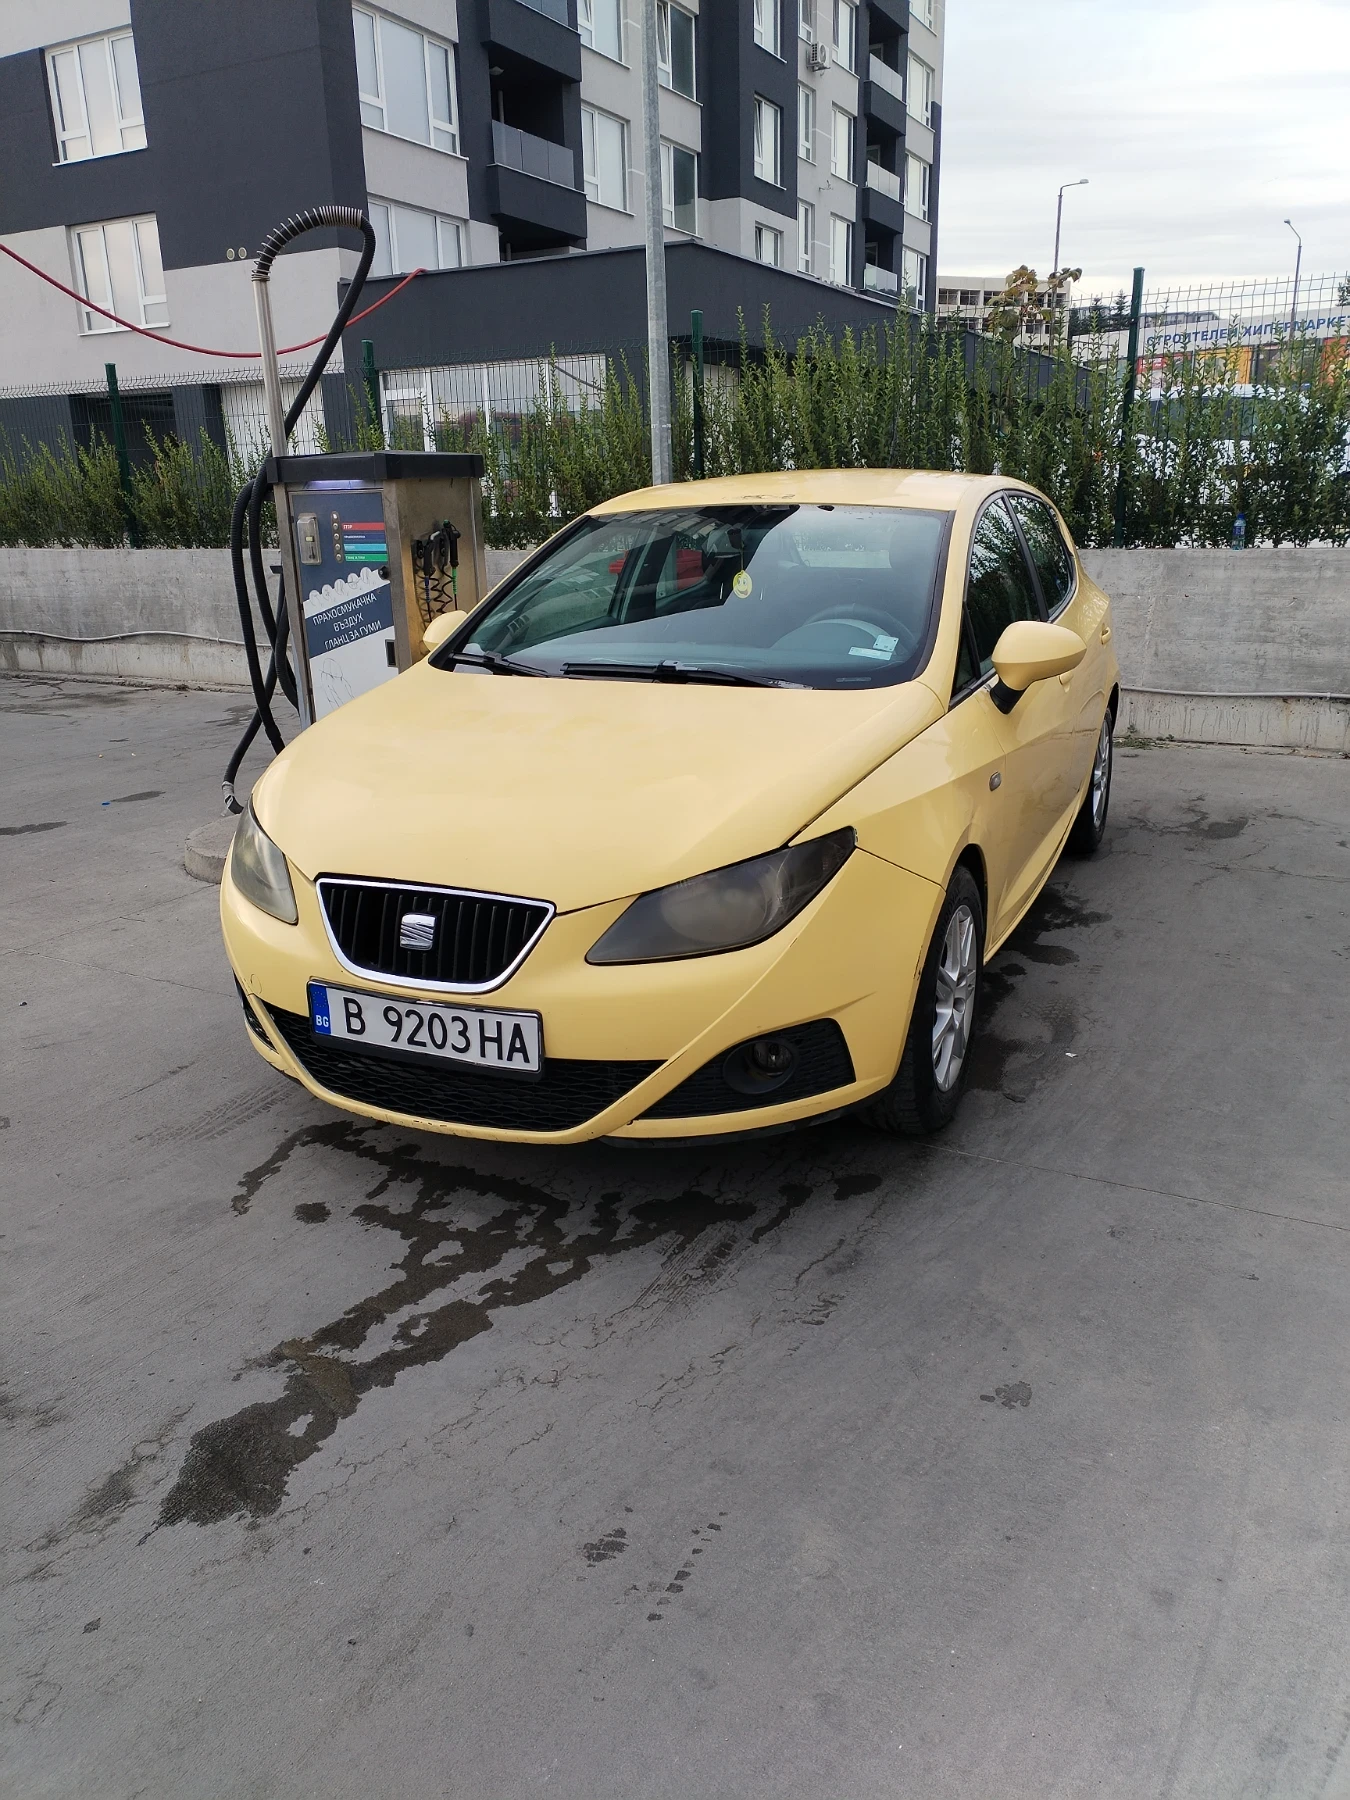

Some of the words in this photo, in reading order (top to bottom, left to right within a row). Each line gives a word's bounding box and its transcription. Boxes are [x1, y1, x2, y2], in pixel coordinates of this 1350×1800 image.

[1243, 315, 1350, 337] ХИПЕРМАРКЕ
[312, 592, 377, 626] ПРАХОСМУКАЧКА
[324, 634, 350, 650] ГЛАНЦ
[349, 630, 360, 641] ЗА
[360, 620, 382, 635] ГУМИ
[333, 613, 364, 632] ВЪЗДУХ
[315, 1014, 329, 1028] BG
[342, 996, 366, 1035] B
[382, 1005, 471, 1054] 9203
[478, 1018, 531, 1064] HA
